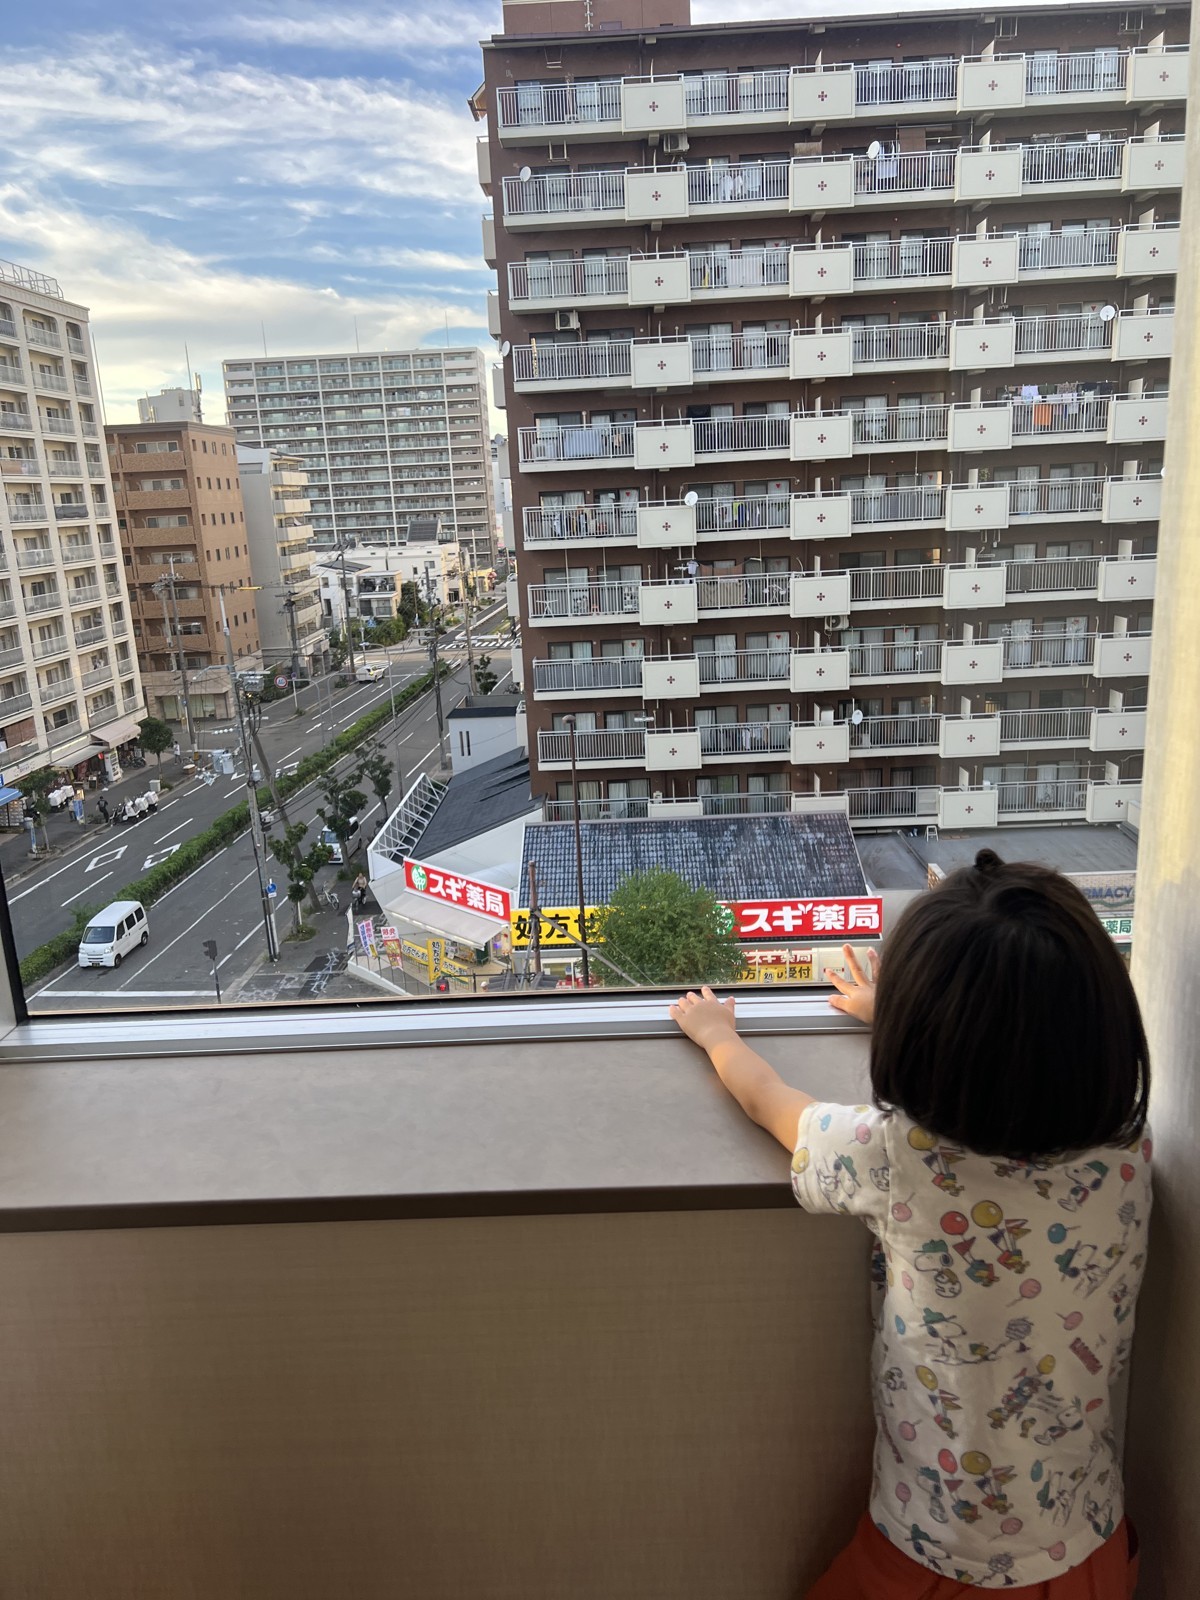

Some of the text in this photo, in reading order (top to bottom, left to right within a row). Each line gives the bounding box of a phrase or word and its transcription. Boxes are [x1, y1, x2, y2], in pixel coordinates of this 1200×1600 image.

[429, 873, 505, 917] スギ薬局
[740, 902, 880, 933] スギ薬局
